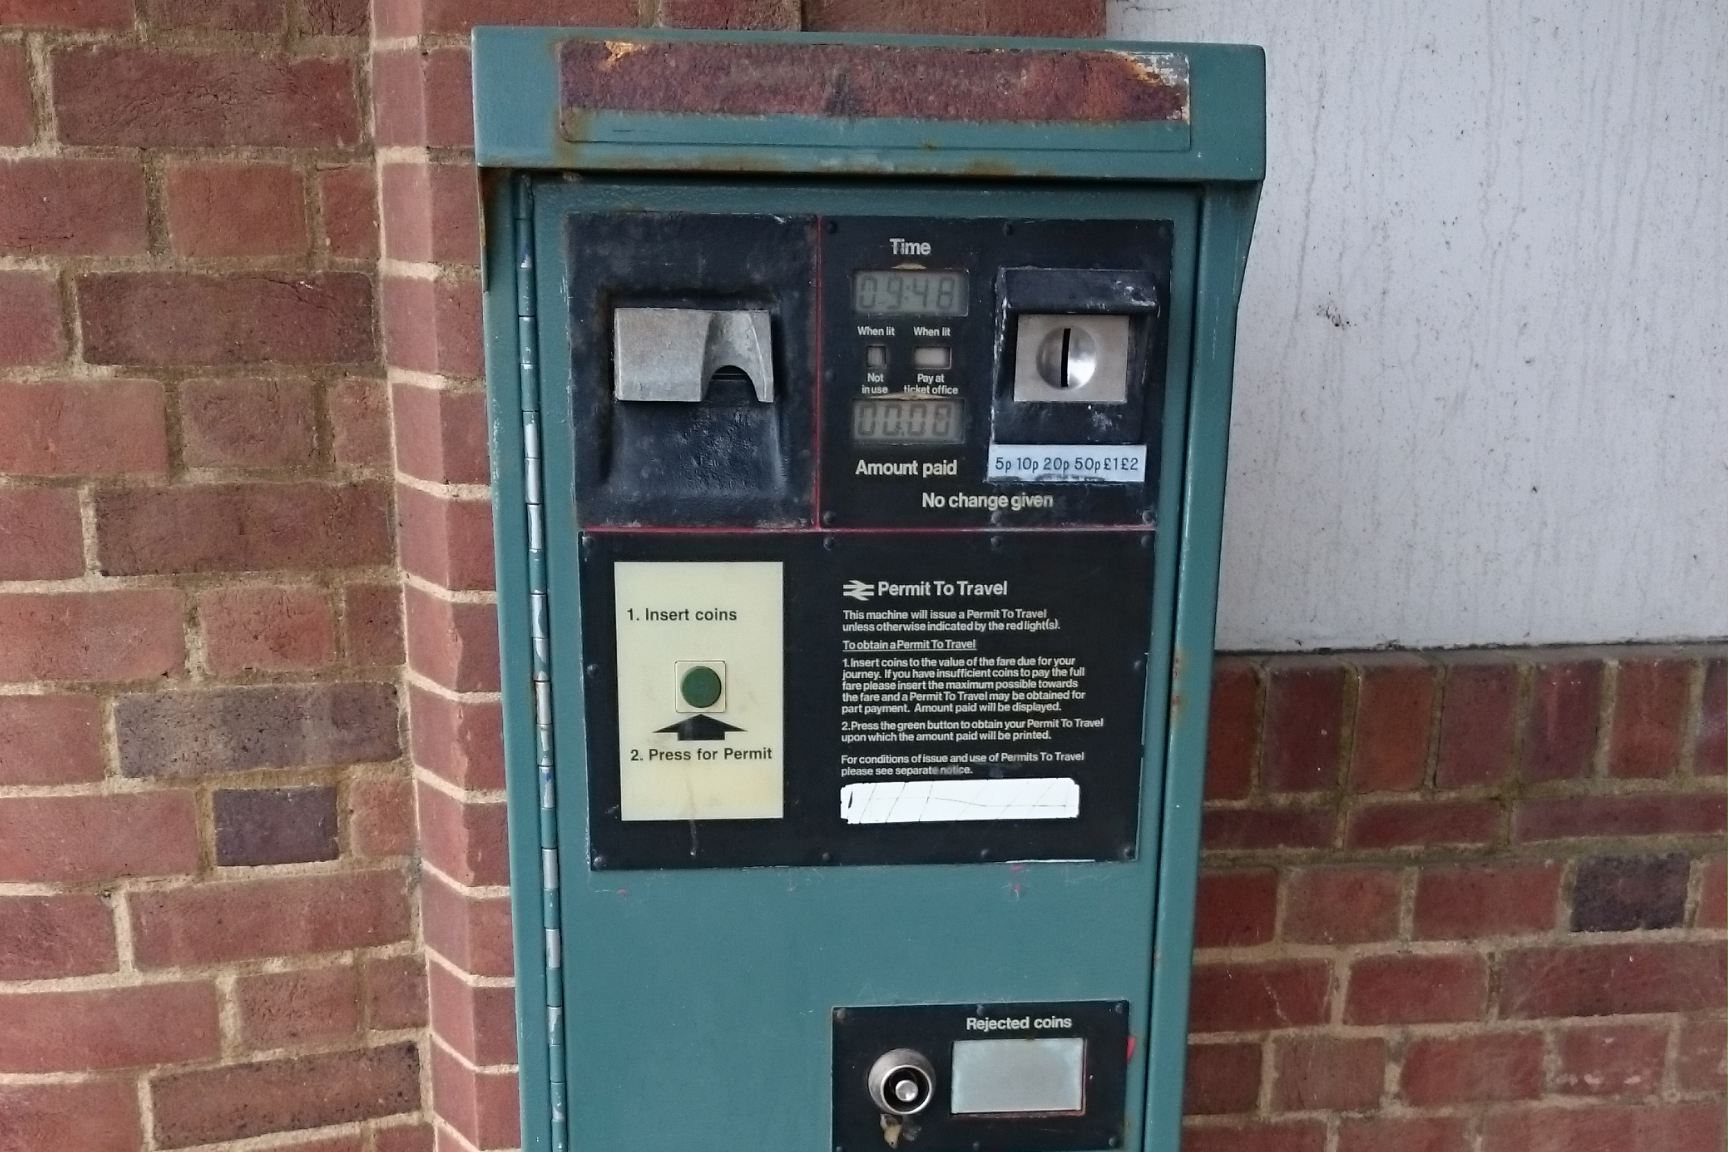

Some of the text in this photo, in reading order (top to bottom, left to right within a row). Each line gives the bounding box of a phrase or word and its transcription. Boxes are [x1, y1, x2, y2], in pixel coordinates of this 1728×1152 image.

[889, 238, 931, 255] Time
[857, 326, 895, 336] When lit
[913, 326, 951, 337] When lit
[867, 373, 884, 383] Not
[917, 373, 945, 384] Pay at
[862, 385, 888, 394] in use
[904, 385, 958, 395] ticket office
[855, 460, 957, 478] Amount paid
[995, 457, 1139, 473] 5p 10p 20p 50p £1 £2
[922, 492, 1053, 511] No change given
[877, 580, 1008, 596] Permit To Travel
[627, 608, 737, 621] 1. Insert coins
[843, 611, 865, 619] This
[866, 610, 909, 619] machine
[911, 610, 928, 619] will
[930, 610, 957, 619] issue
[966, 610, 1000, 619] Permit
[1001, 610, 1014, 618] To
[1015, 609, 1047, 618] Travel
[842, 620, 1061, 633] unless otherwise indicated by the red light(s).
[843, 641, 856, 650] To
[857, 641, 888, 649] obtain
[897, 640, 930, 649] Permit
[931, 640, 944, 649] To
[945, 640, 976, 649] Travel
[881, 658, 908, 667] coins
[909, 658, 920, 667] to
[921, 658, 937, 667] the
[938, 658, 965, 666] value
[966, 658, 978, 666] of
[979, 658, 995, 666] the
[996, 657, 1016, 666] fare
[1017, 657, 1036, 666] due
[1037, 657, 1052, 666] for
[1053, 659, 1076, 668] your
[842, 668, 1085, 680] journey. If you have insufficient coins to pay the full
[842, 680, 1078, 692] fare please insert the maximum possible towards
[842, 692, 858, 701] the
[860, 692, 880, 701] fare
[881, 692, 900, 701] and
[909, 692, 943, 701] Permit
[944, 691, 957, 700] To
[958, 691, 988, 700] Travel
[989, 693, 1010, 702] may
[1012, 691, 1025, 700] be
[1026, 691, 1070, 699] obtained
[1071, 690, 1086, 699] for
[841, 702, 1061, 715] part payment. Amount paid will be displayed.
[881, 721, 896, 730] the
[897, 723, 925, 732] green
[927, 720, 960, 729] button
[960, 720, 971, 729] to
[971, 720, 1003, 728] obtain
[1004, 721, 1026, 730] your
[1027, 719, 1060, 728] Permit
[1061, 719, 1074, 727] To
[1075, 719, 1104, 727] Travel
[841, 731, 1051, 744] upon which the amount paid will be printed.
[630, 747, 773, 761] 2. Press for Permit
[841, 755, 858, 764] For
[859, 755, 909, 763] conditions
[911, 754, 922, 763] of
[922, 754, 948, 763] issue
[950, 754, 968, 762] and
[989, 753, 999, 762] of
[1001, 753, 1038, 762] Permits
[1040, 753, 1053, 761] To
[1054, 752, 1084, 761] Travel
[841, 766, 874, 777] please
[895, 766, 939, 776] separate
[940, 765, 973, 774] notice.
[966, 1016, 1072, 1032] Rejected coins
